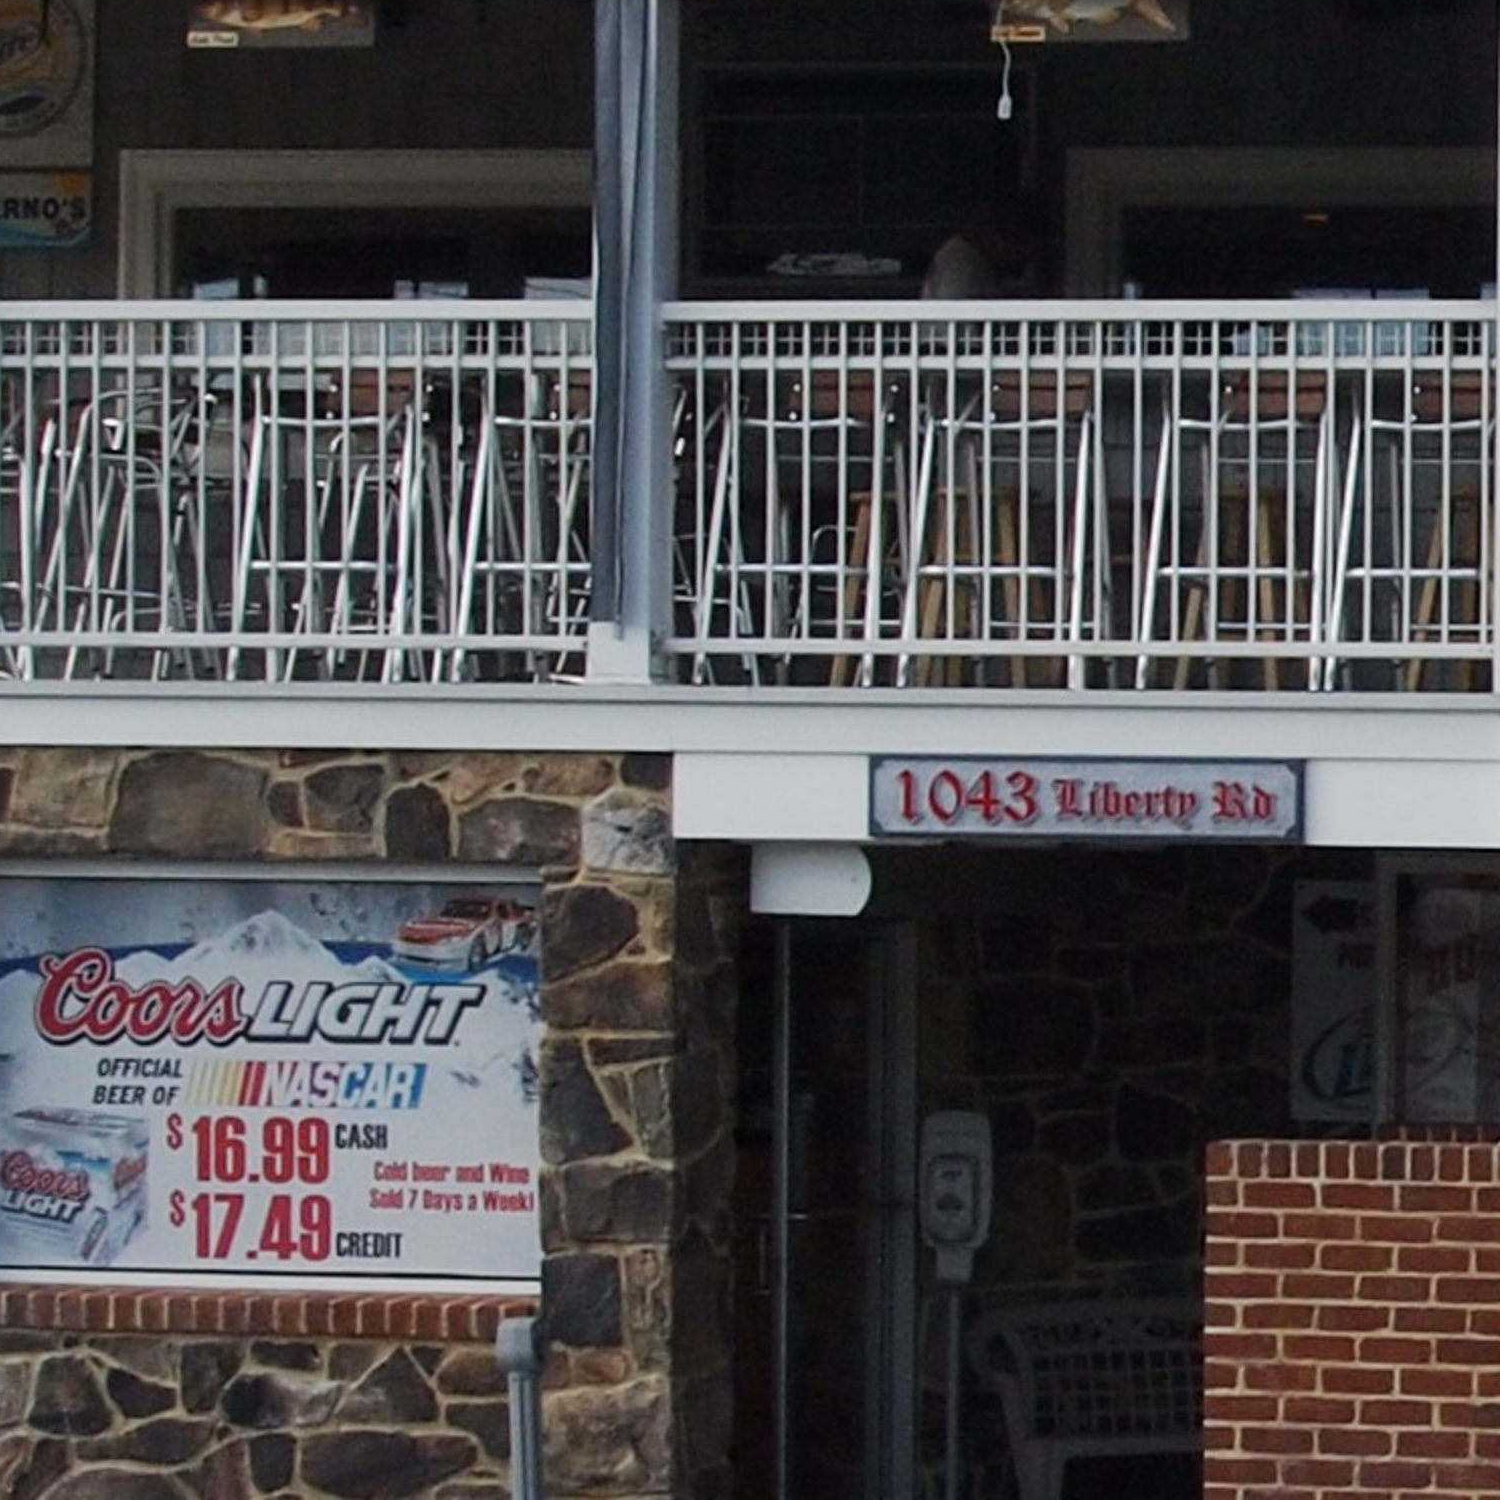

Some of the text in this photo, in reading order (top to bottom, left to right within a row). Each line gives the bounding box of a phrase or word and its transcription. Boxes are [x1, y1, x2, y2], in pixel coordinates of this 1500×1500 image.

[897, 768, 1278, 830] 1043 Liberty Rd
[34, 945, 487, 1046] Coors LIGHT
[97, 1057, 183, 1079] OFFICIAL
[94, 1085, 180, 1106] BEER OF
[257, 1061, 418, 1109] NASCAR
[334, 1123, 388, 1150] CASH
[0, 1150, 90, 1201] Coors
[374, 1160, 530, 1184] Cold beer and Wine
[0, 1186, 83, 1224] LIGHT
[369, 1188, 534, 1213] Sold 7 Days a Week!
[335, 1232, 403, 1260] CREDIT
